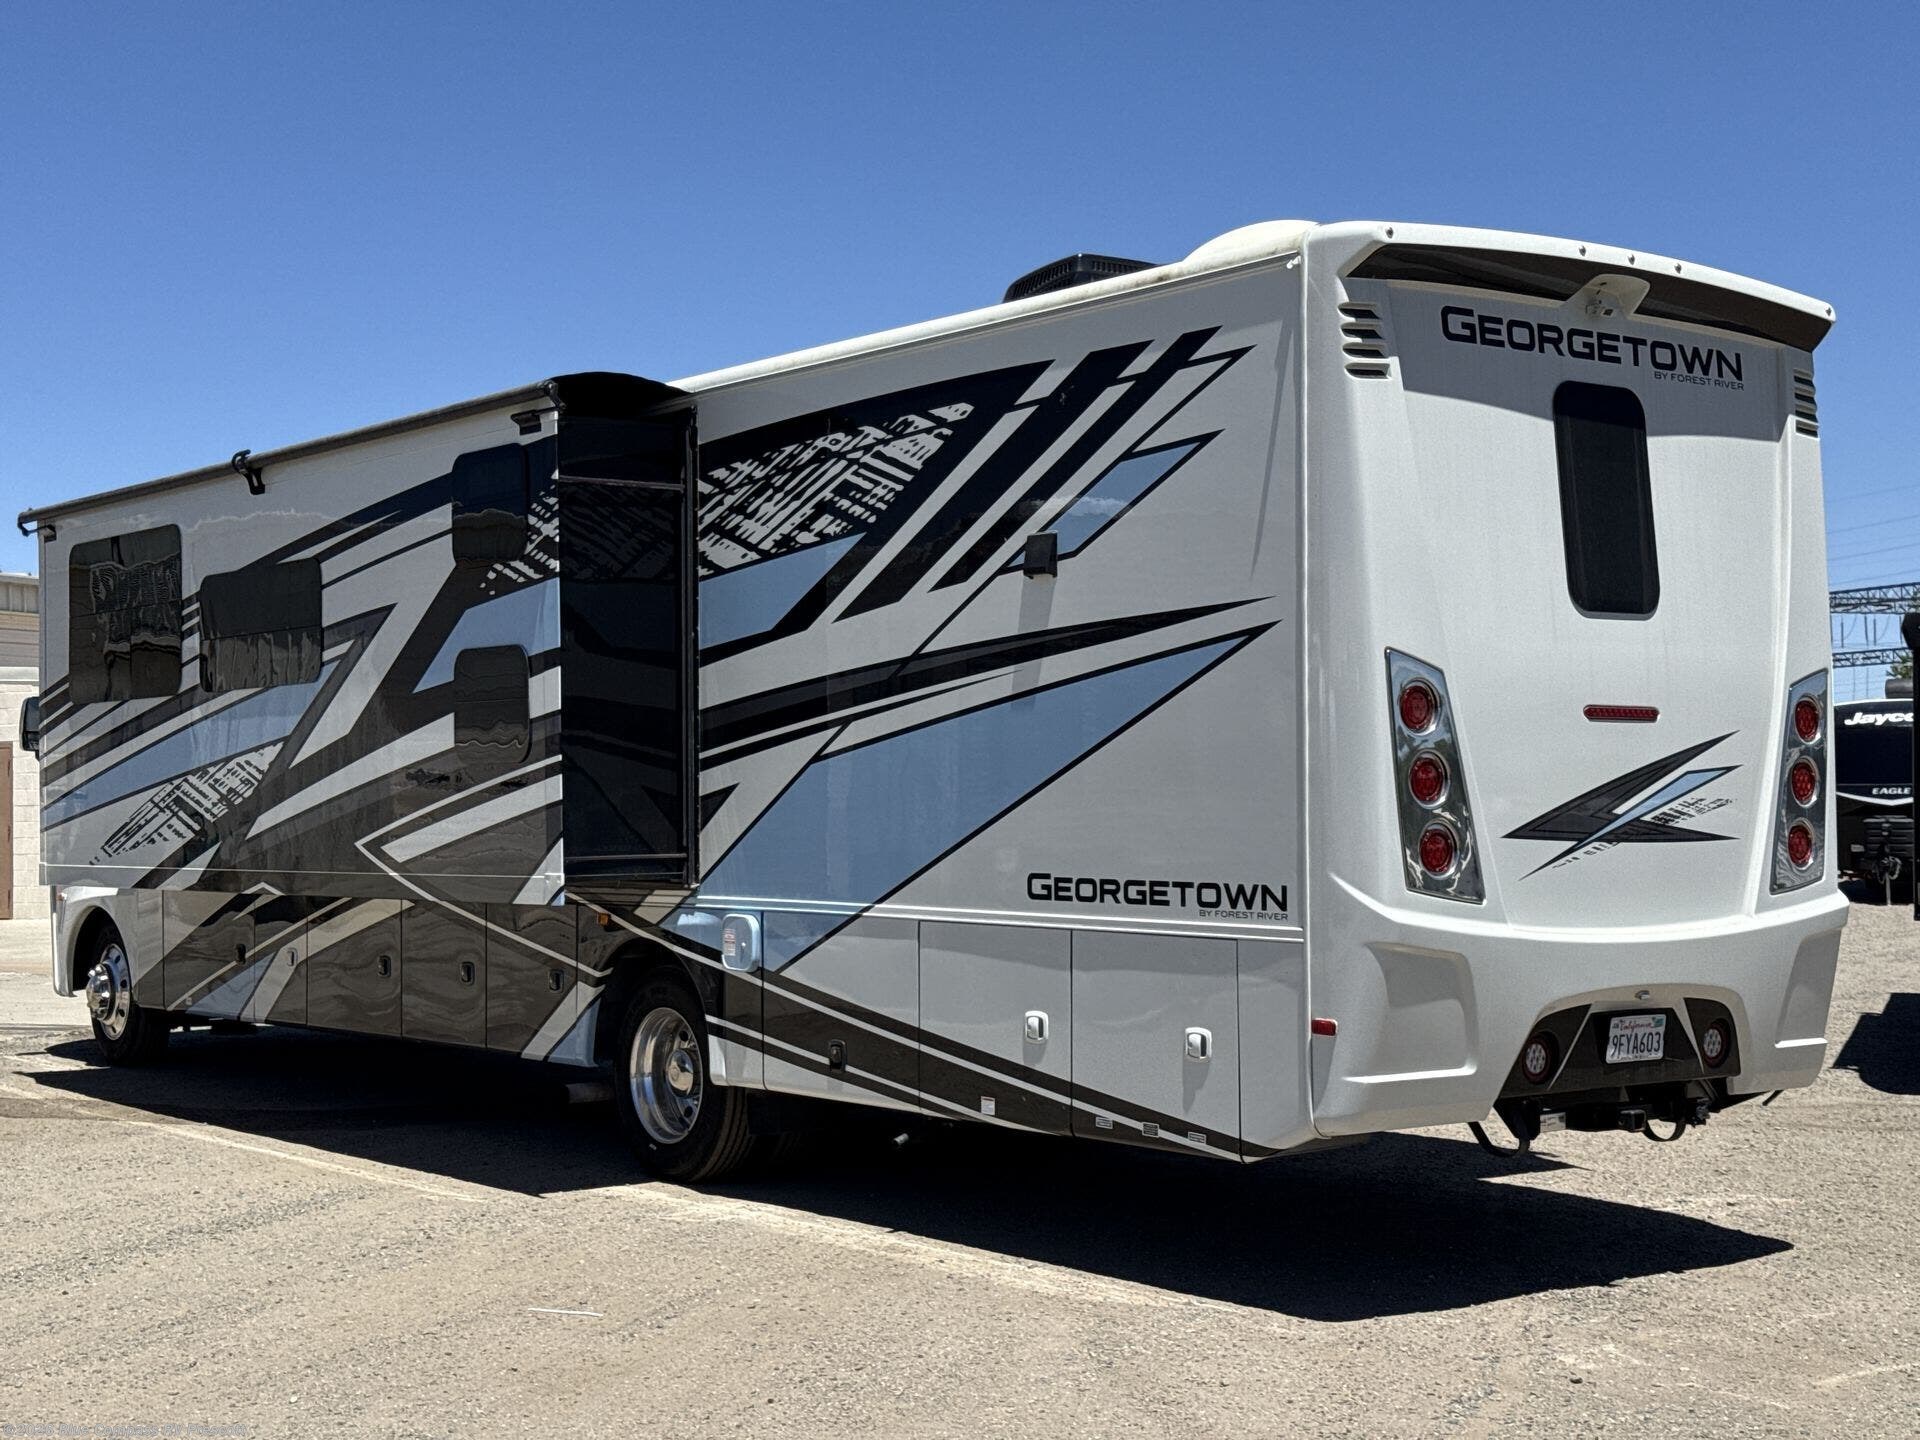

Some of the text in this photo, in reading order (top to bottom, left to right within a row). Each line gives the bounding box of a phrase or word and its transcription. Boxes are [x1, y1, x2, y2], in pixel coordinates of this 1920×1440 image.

[1440, 305, 1743, 382] GEORGETOWN
[1654, 371, 1744, 391] BY FOREST RIVER
[1872, 787, 1911, 795] EAGLE
[1027, 873, 1288, 912] GEORGETOWN
[1199, 909, 1288, 921] BY FOREST RIVER
[1611, 1032, 1661, 1057] 9FYA603
